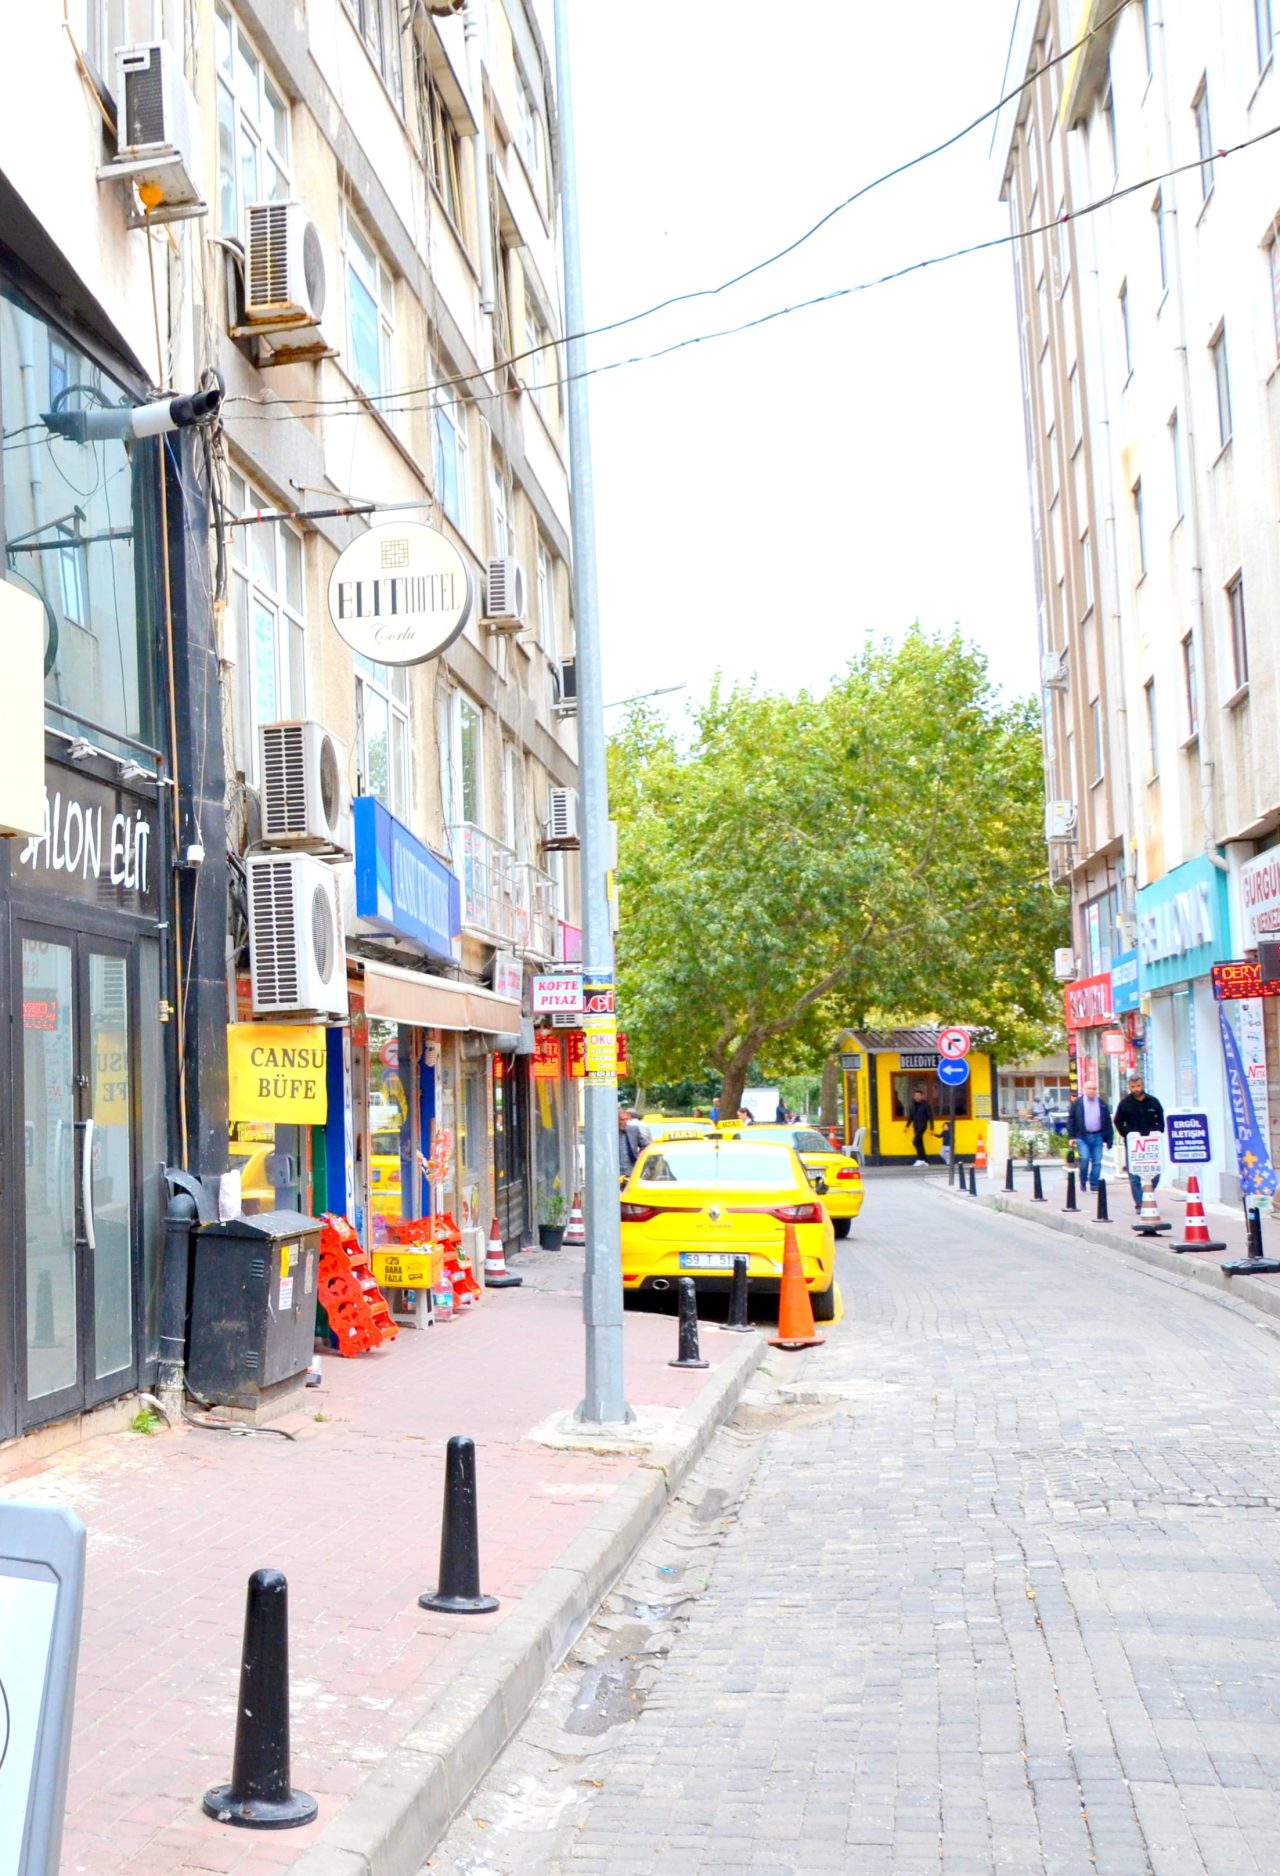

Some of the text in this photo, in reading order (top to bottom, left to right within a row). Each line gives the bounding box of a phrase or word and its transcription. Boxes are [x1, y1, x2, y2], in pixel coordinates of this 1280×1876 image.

[337, 572, 460, 619] ELIT HOTEL
[19, 785, 102, 880] ALON
[251, 1047, 327, 1068] CANSU
[258, 1074, 316, 1100] BÜFE
[687, 1254, 700, 1265] 59
[707, 1255, 713, 1264] T
